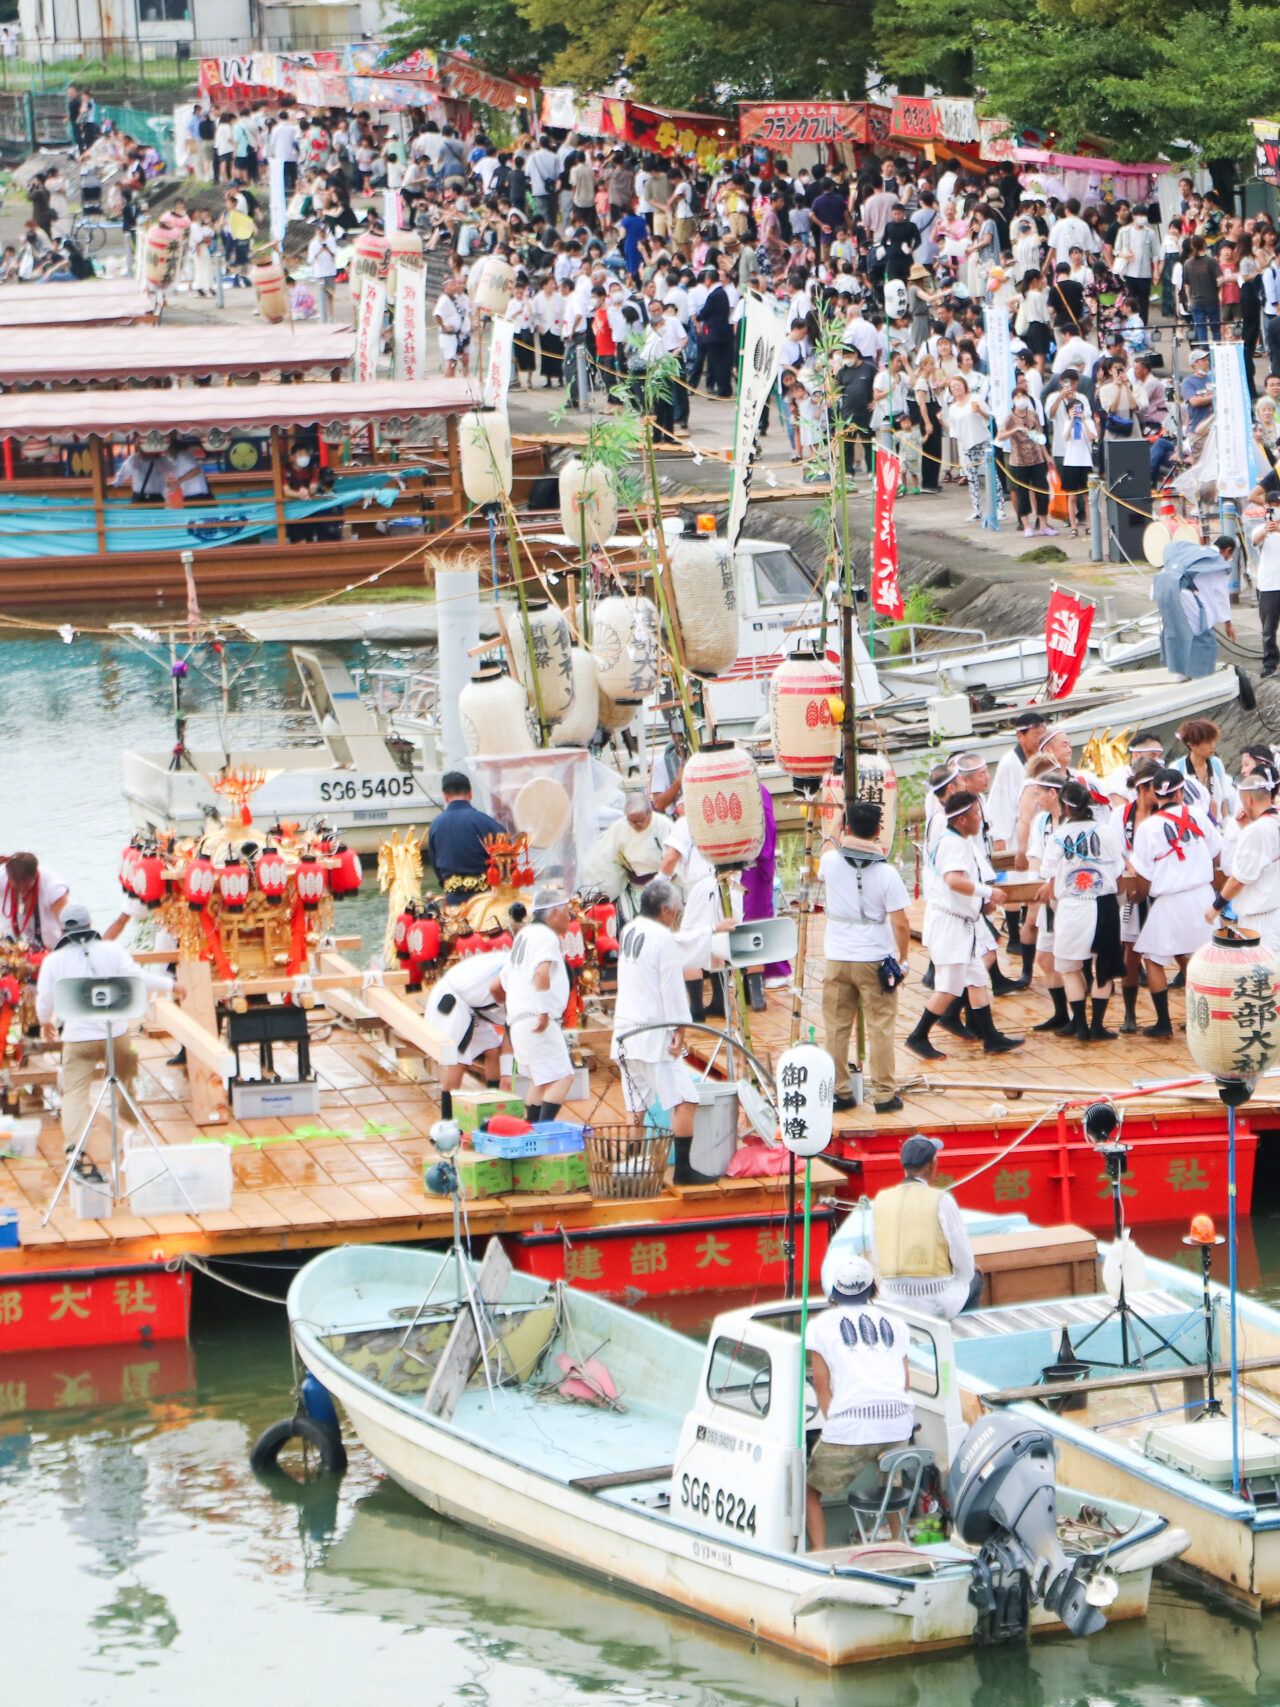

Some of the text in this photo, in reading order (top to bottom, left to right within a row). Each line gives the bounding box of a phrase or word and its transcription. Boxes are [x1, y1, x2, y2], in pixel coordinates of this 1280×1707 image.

[764, 117, 843, 141] フランクフルト
[1230, 963, 1278, 1075] 建部大社
[782, 1062, 809, 1140] 御神燈
[565, 1230, 790, 1281] 建部大社
[964, 1425, 996, 1463] YAMAHA
